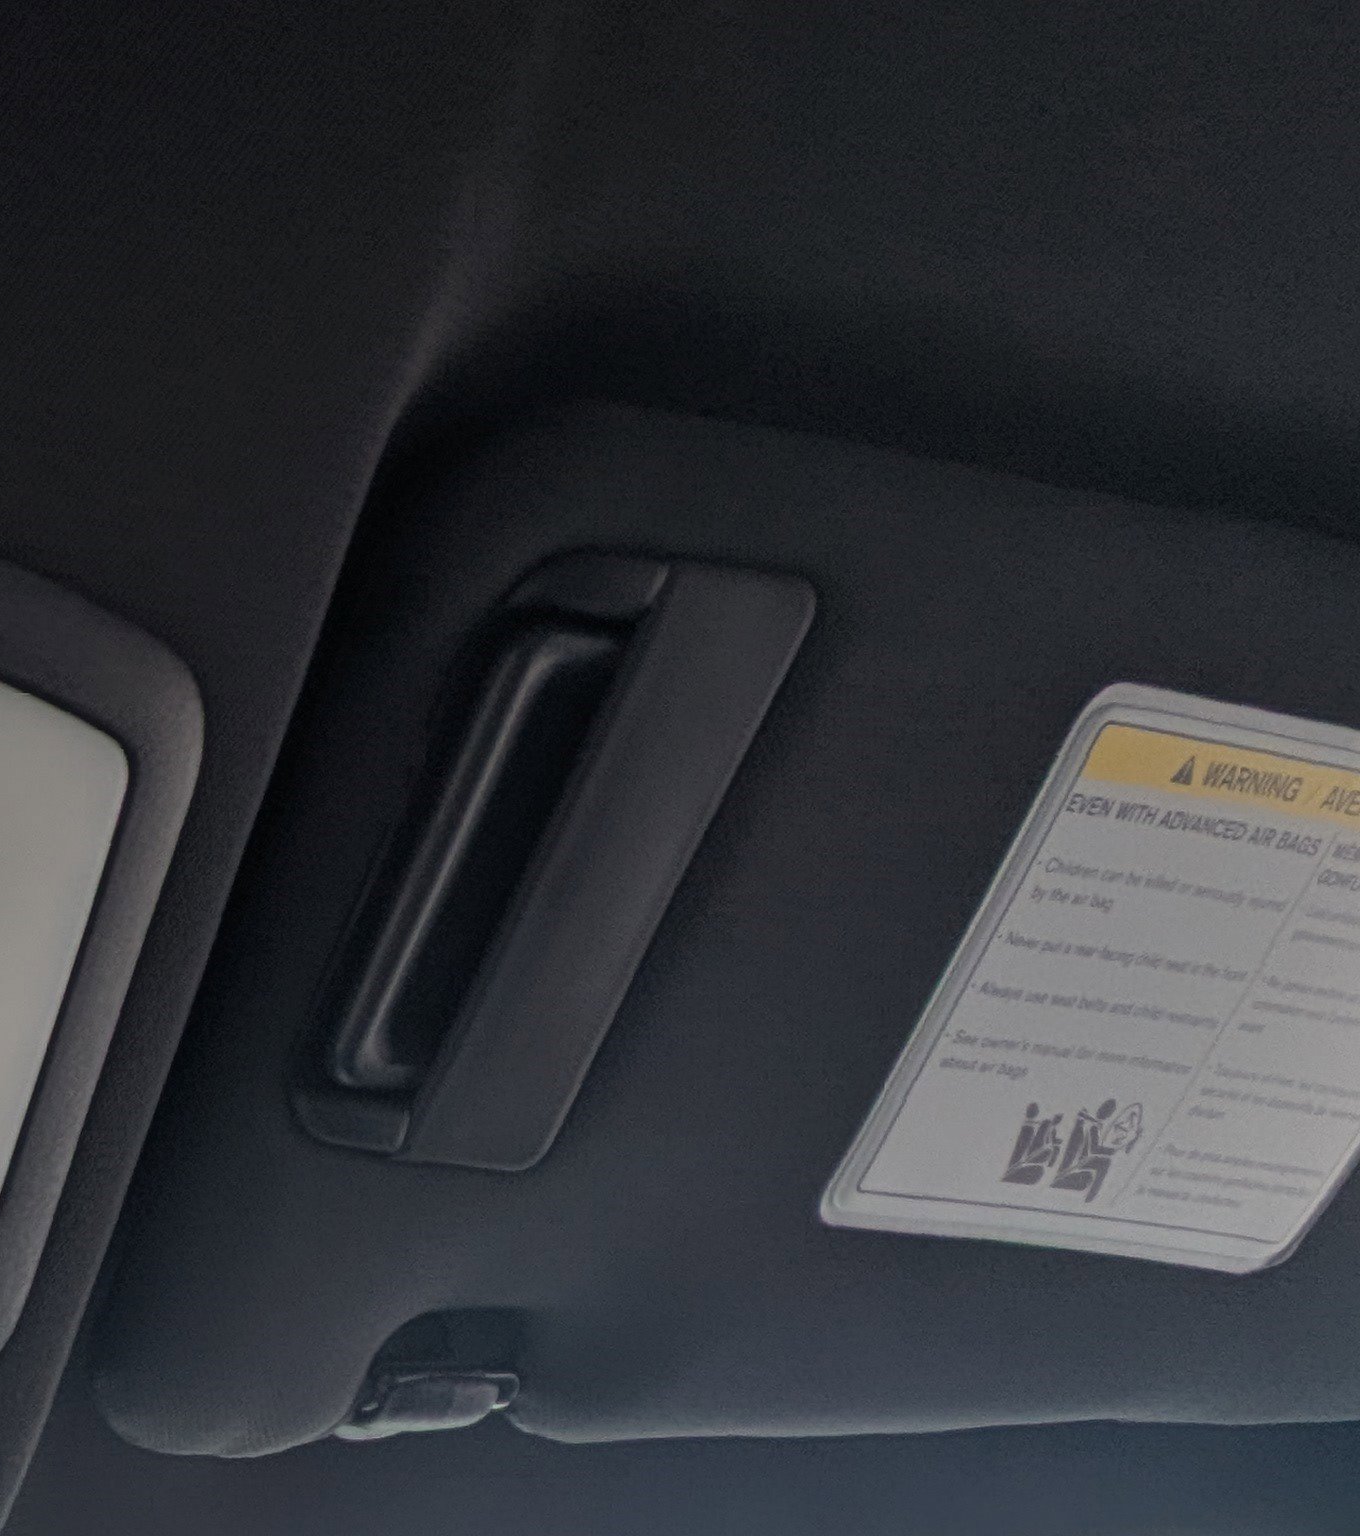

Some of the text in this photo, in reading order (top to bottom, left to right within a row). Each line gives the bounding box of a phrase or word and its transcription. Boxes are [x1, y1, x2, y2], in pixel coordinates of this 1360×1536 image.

[1202, 761, 1304, 801] WARNING
[1065, 793, 1322, 855] EVEN WITH ADVANCED AIR BAGS
